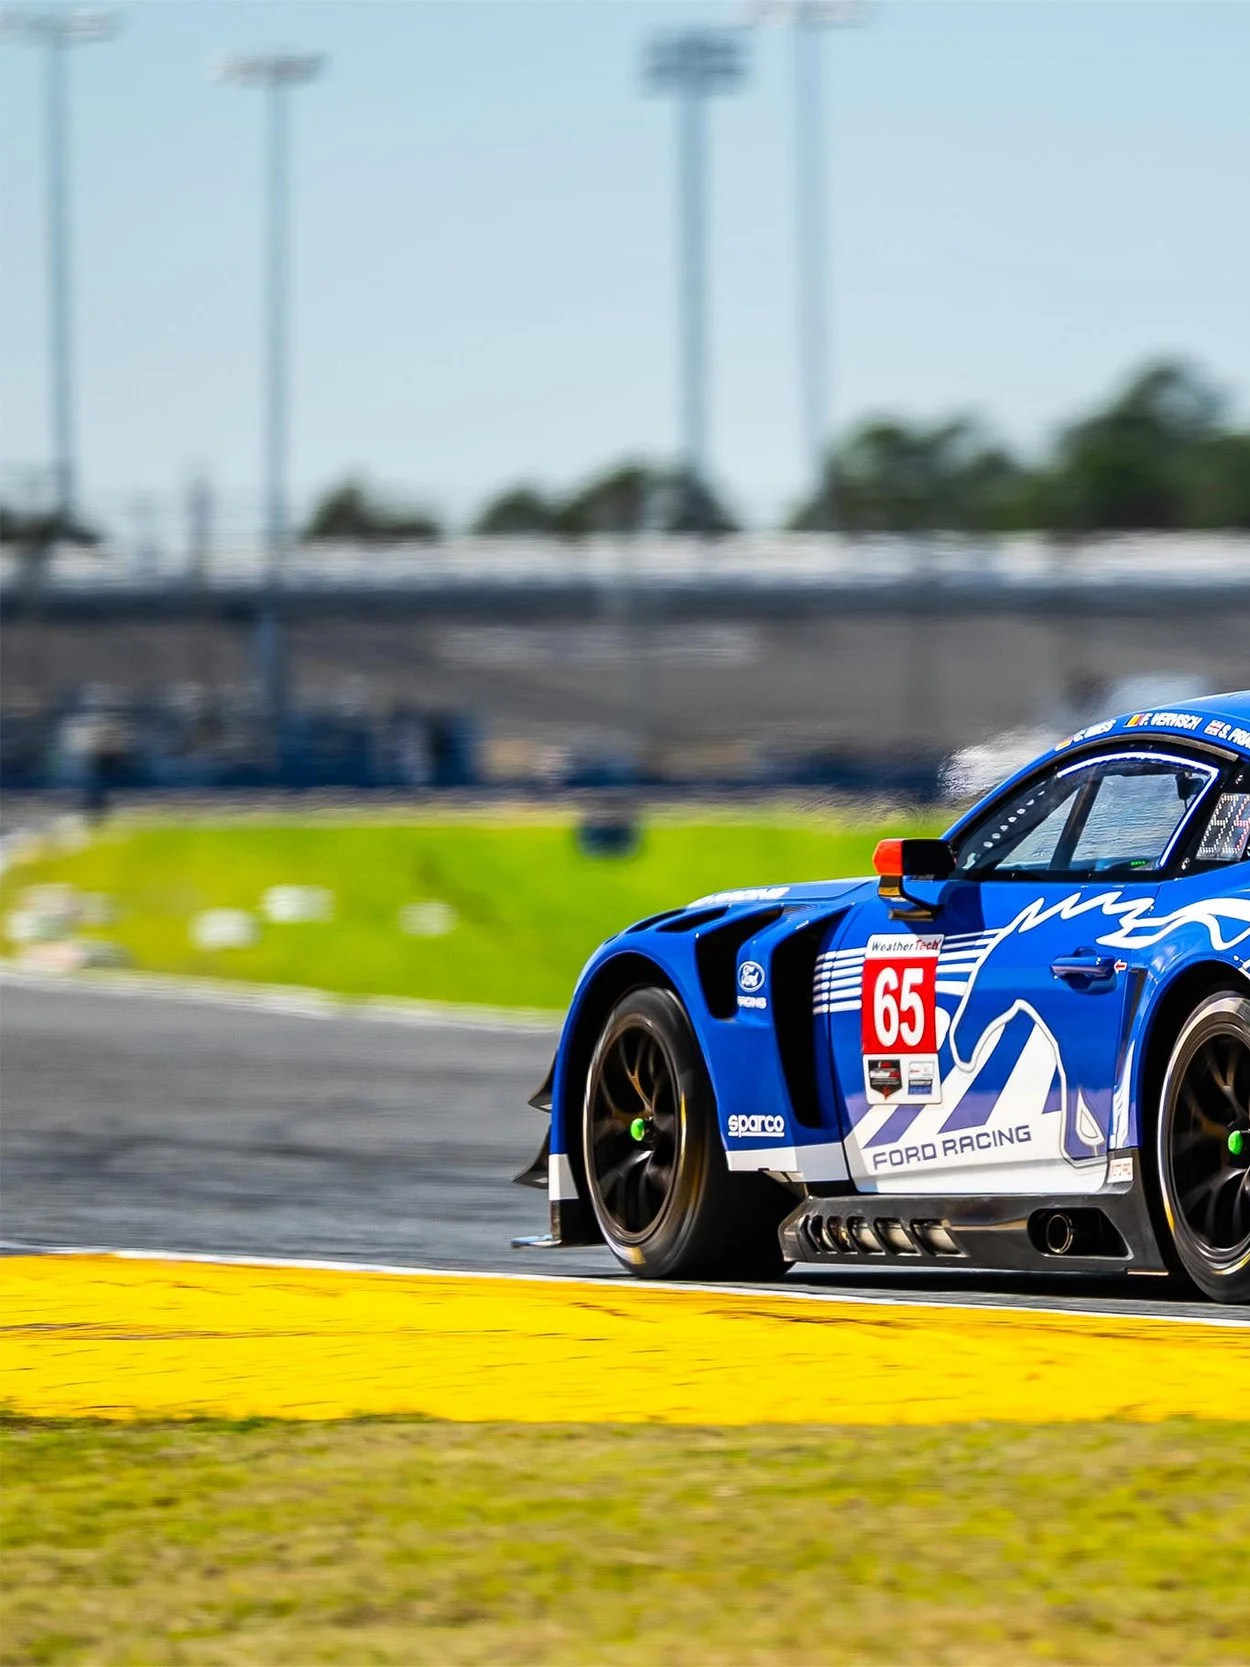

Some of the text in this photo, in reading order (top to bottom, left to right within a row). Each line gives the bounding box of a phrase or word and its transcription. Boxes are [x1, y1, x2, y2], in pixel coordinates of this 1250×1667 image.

[871, 938, 941, 952] WeatherTech
[873, 967, 925, 1048] 65
[727, 1114, 785, 1137] sparco
[872, 1124, 1032, 1171] FORD RACING
